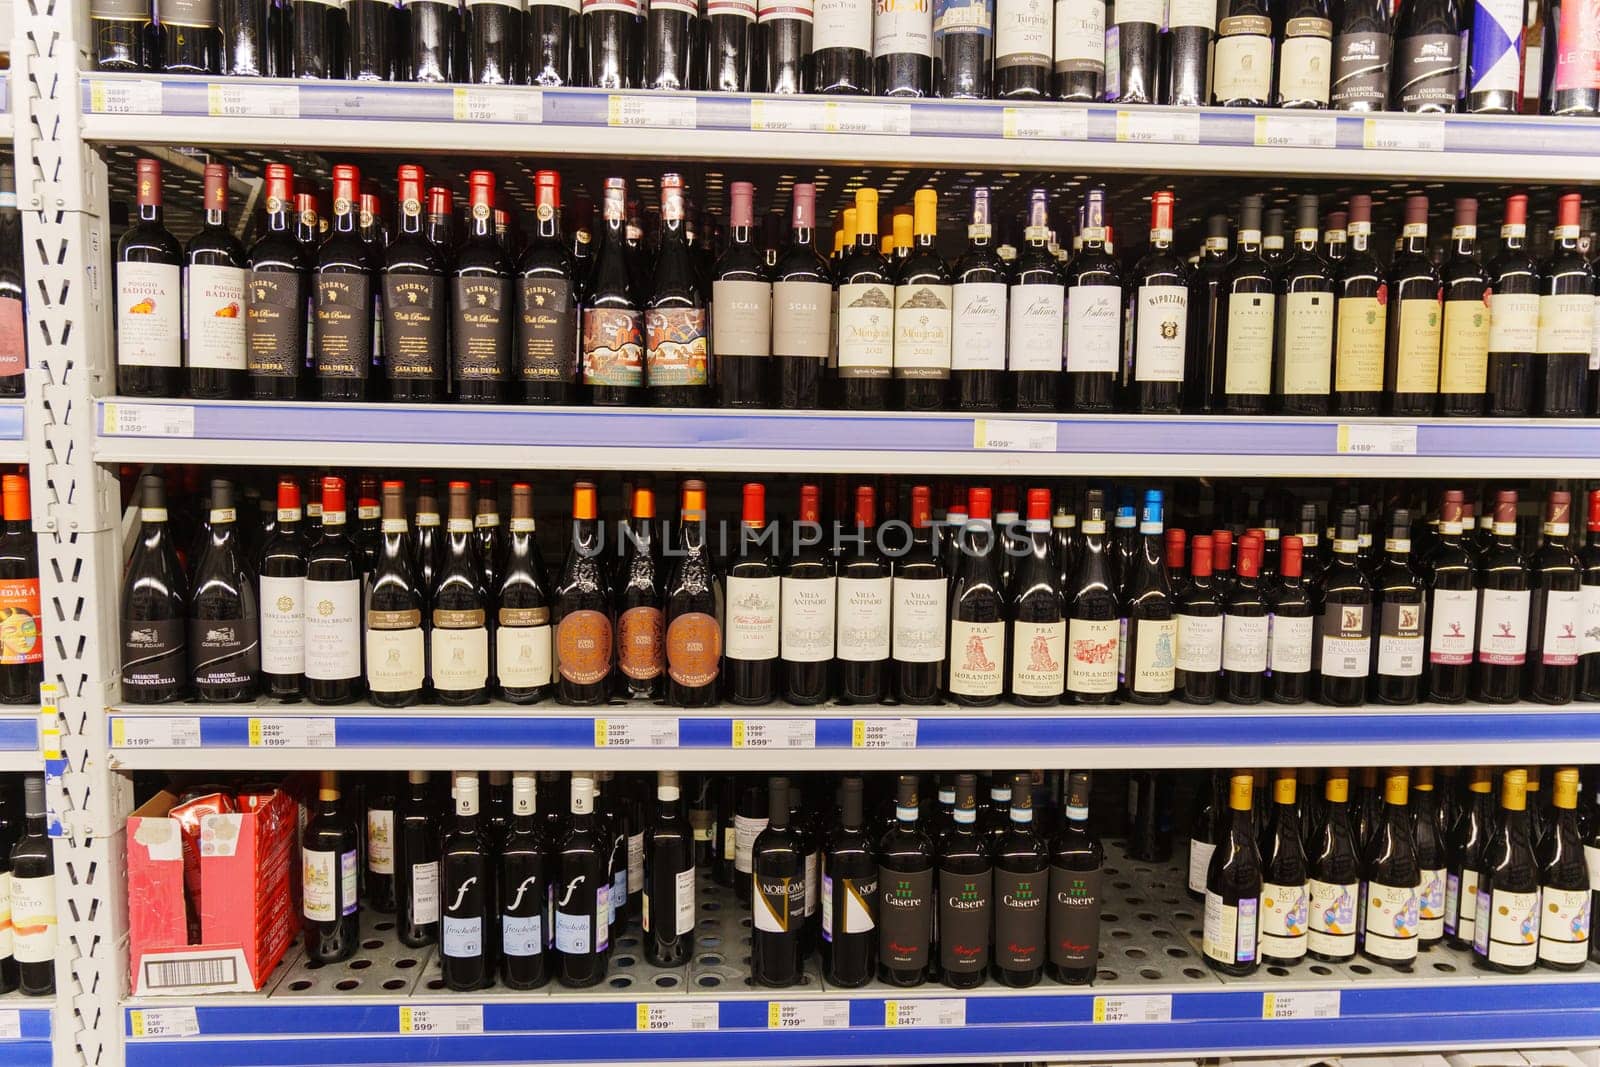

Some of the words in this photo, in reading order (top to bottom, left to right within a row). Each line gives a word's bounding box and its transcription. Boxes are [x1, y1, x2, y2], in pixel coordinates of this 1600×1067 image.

[1024, 33, 1042, 41] 2017
[1, 588, 36, 597] EDARA
[885, 892, 921, 907] Casere
[949, 896, 985, 909] Casere
[1003, 894, 1040, 908] Casere
[1058, 891, 1095, 905] Casere
